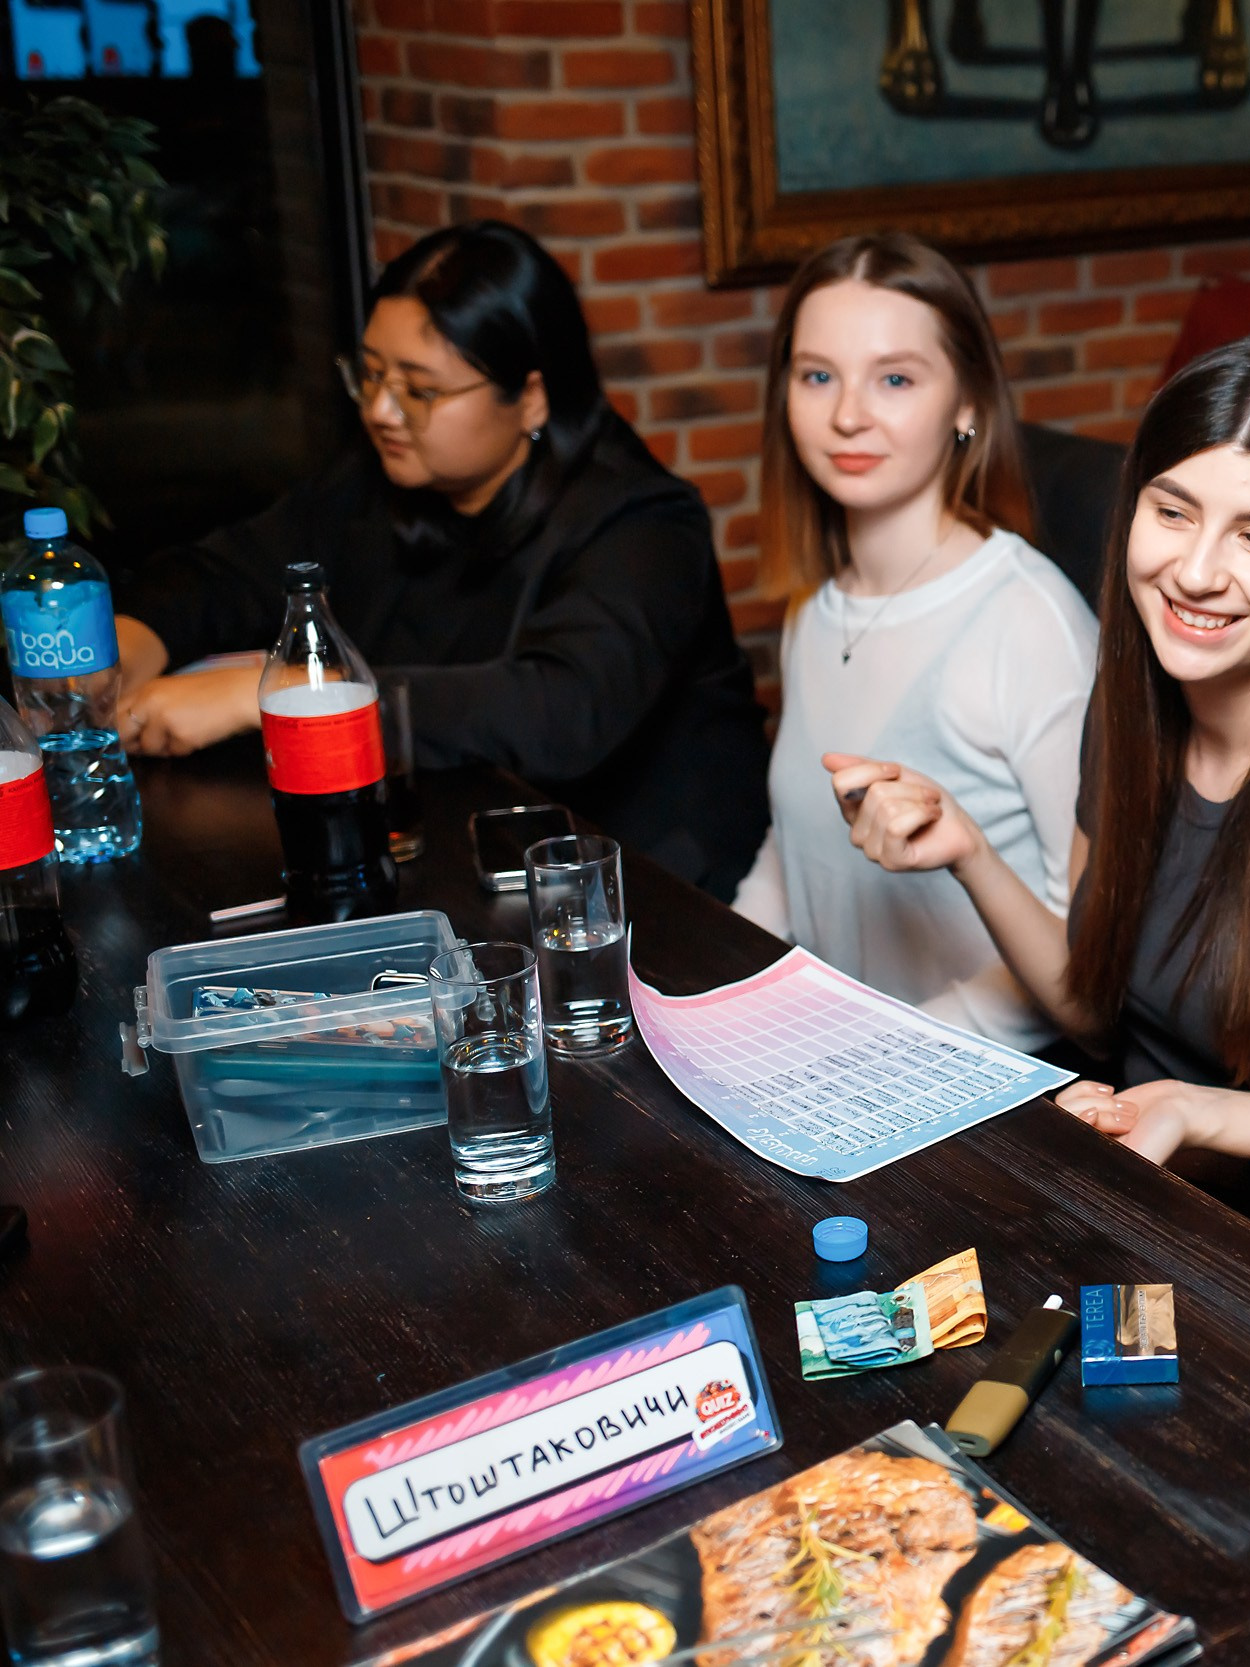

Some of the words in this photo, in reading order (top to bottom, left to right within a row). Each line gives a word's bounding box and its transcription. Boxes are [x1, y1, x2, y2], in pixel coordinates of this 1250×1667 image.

[21, 630, 75, 650] bon
[25, 646, 95, 670] aqua
[1085, 1288, 1104, 1330] TEREA
[700, 1391, 736, 1416] QUIZ
